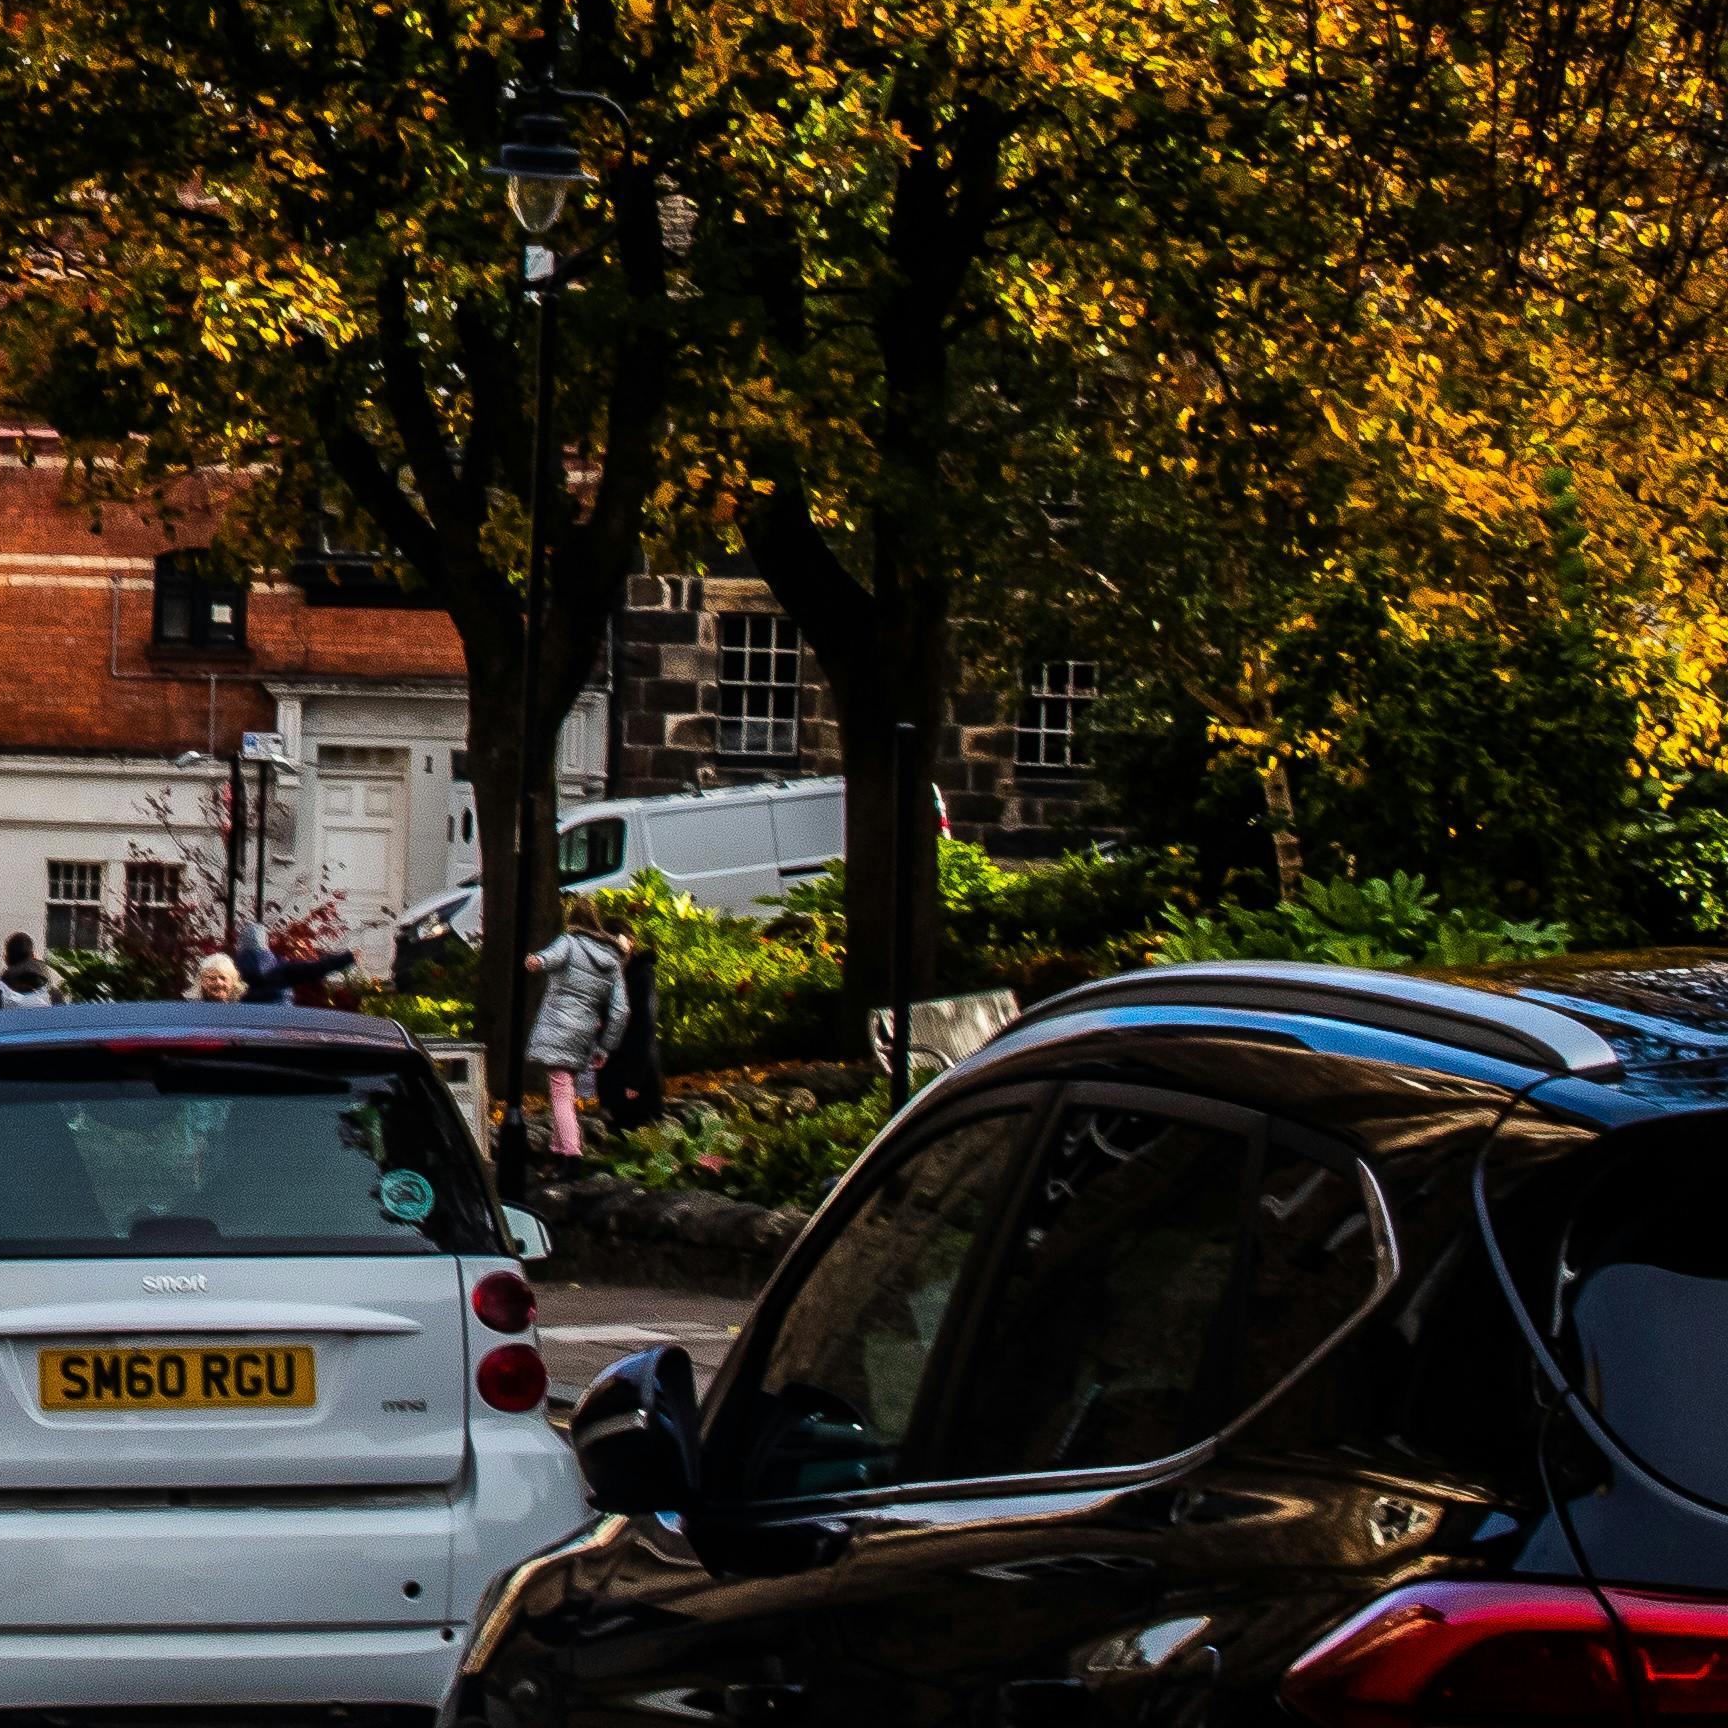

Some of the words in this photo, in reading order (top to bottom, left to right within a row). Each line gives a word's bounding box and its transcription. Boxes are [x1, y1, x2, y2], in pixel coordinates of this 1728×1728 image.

[142, 1273, 208, 1294] smart
[61, 1354, 189, 1401] SM60
[201, 1352, 296, 1398] RGU
